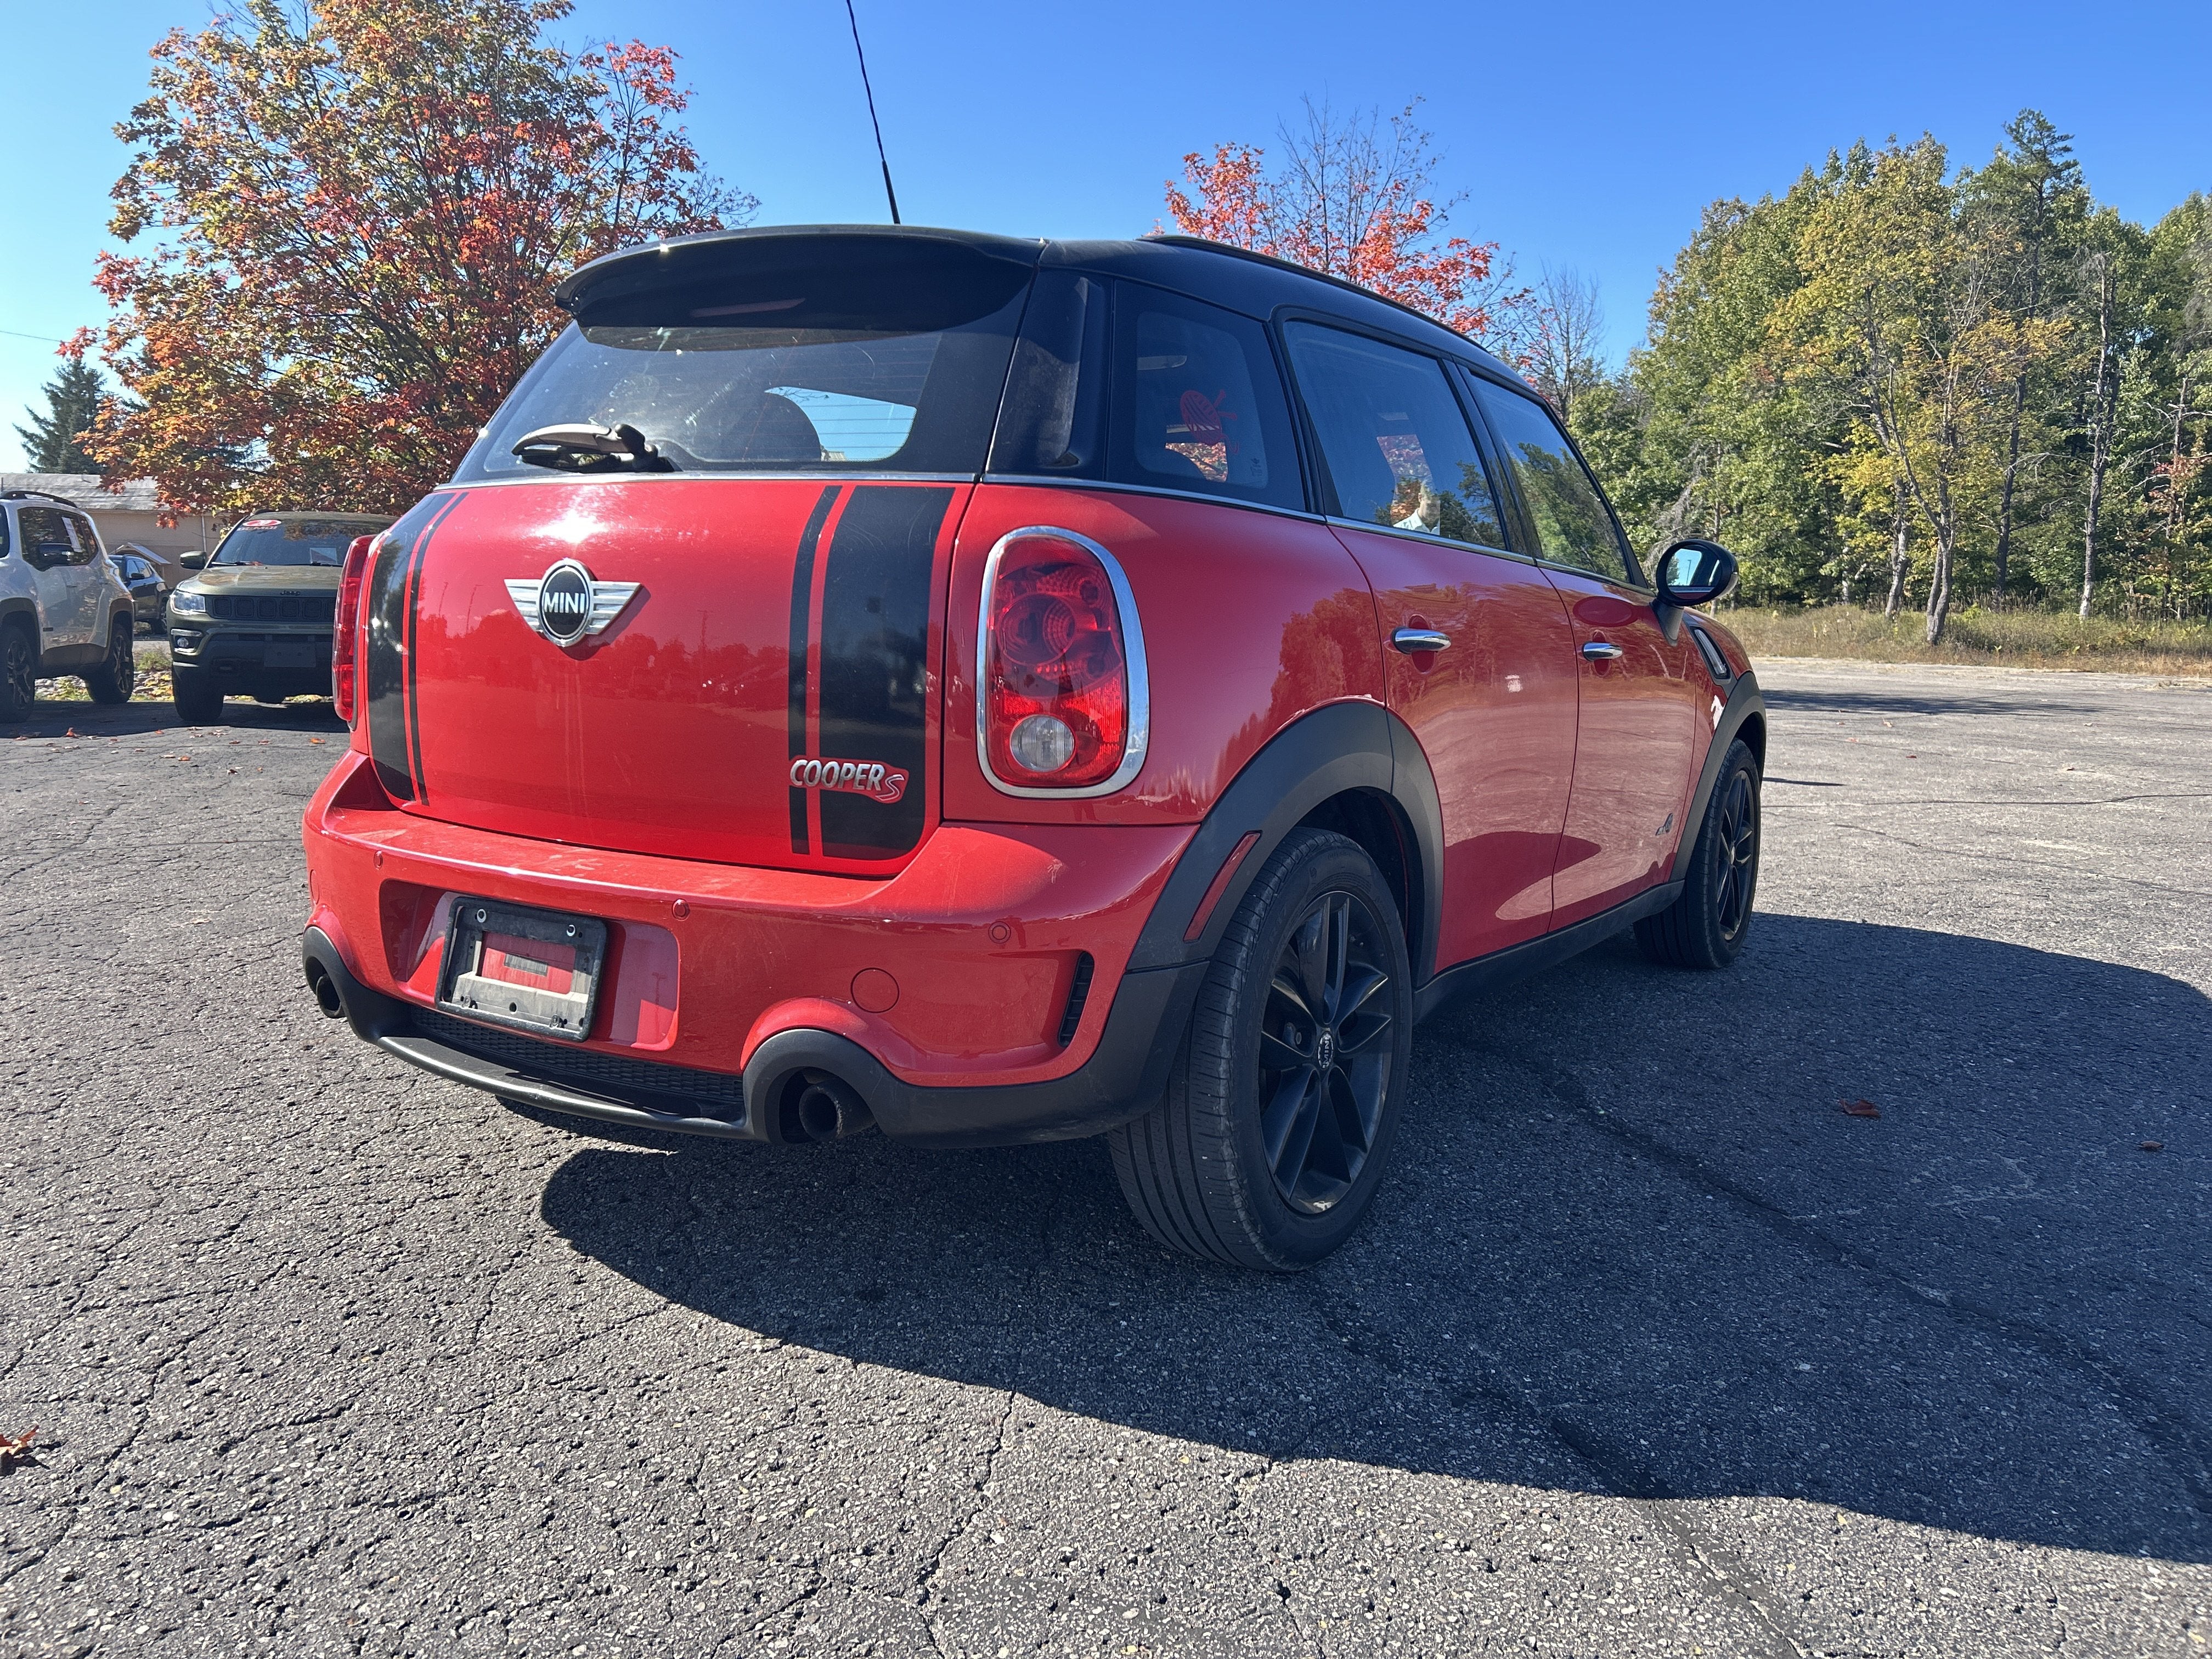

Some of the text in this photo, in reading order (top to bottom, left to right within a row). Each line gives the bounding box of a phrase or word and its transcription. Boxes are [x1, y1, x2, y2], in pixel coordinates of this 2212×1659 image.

[544, 592, 586, 614] MINI
[790, 759, 905, 801] COOPER S
